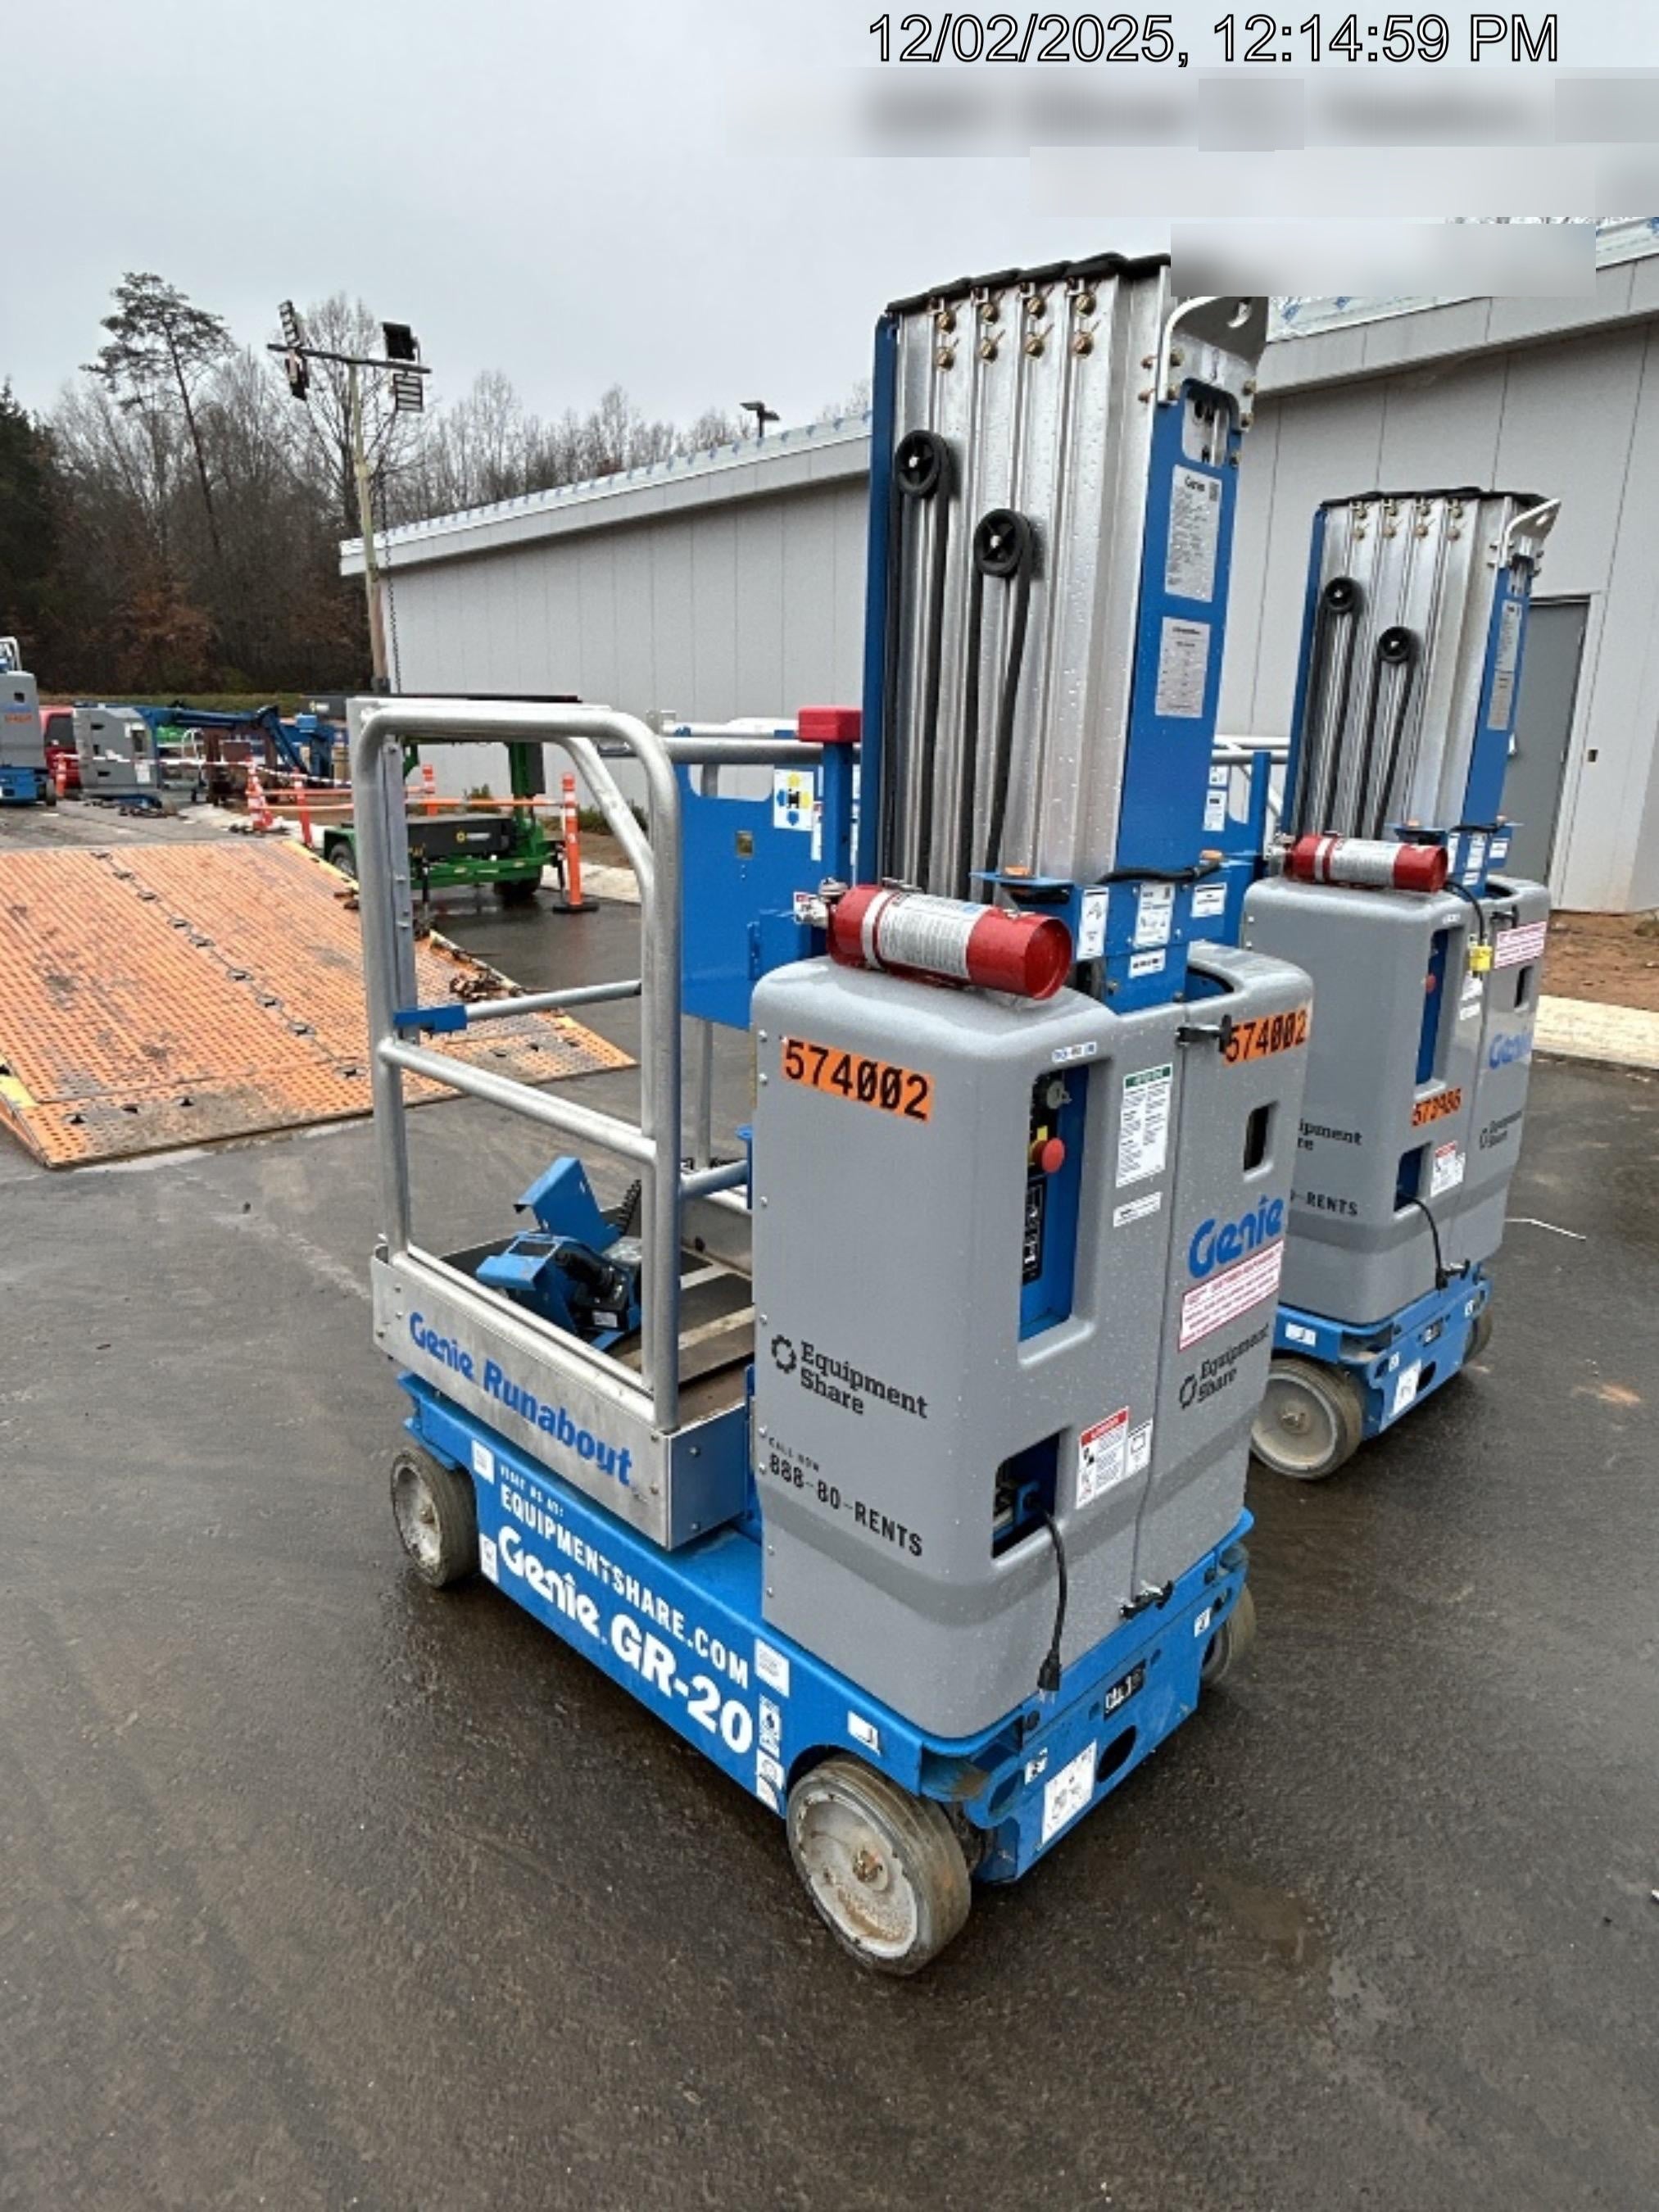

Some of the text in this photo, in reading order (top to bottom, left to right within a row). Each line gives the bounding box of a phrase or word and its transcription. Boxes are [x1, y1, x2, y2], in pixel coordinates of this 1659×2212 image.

[785, 1039, 928, 1122] 574002
[1189, 1194, 1284, 1279] Genie
[410, 1311, 632, 1487] Genie Runabout
[800, 1339, 928, 1419] Equipment
[800, 1366, 864, 1416] Share
[768, 1452, 923, 1557] 888-80-RENTS
[500, 1482, 749, 1690] EQUIPMENTSHARE.COM
[497, 1525, 601, 1639] Genie
[610, 1613, 754, 1753] GR-20
